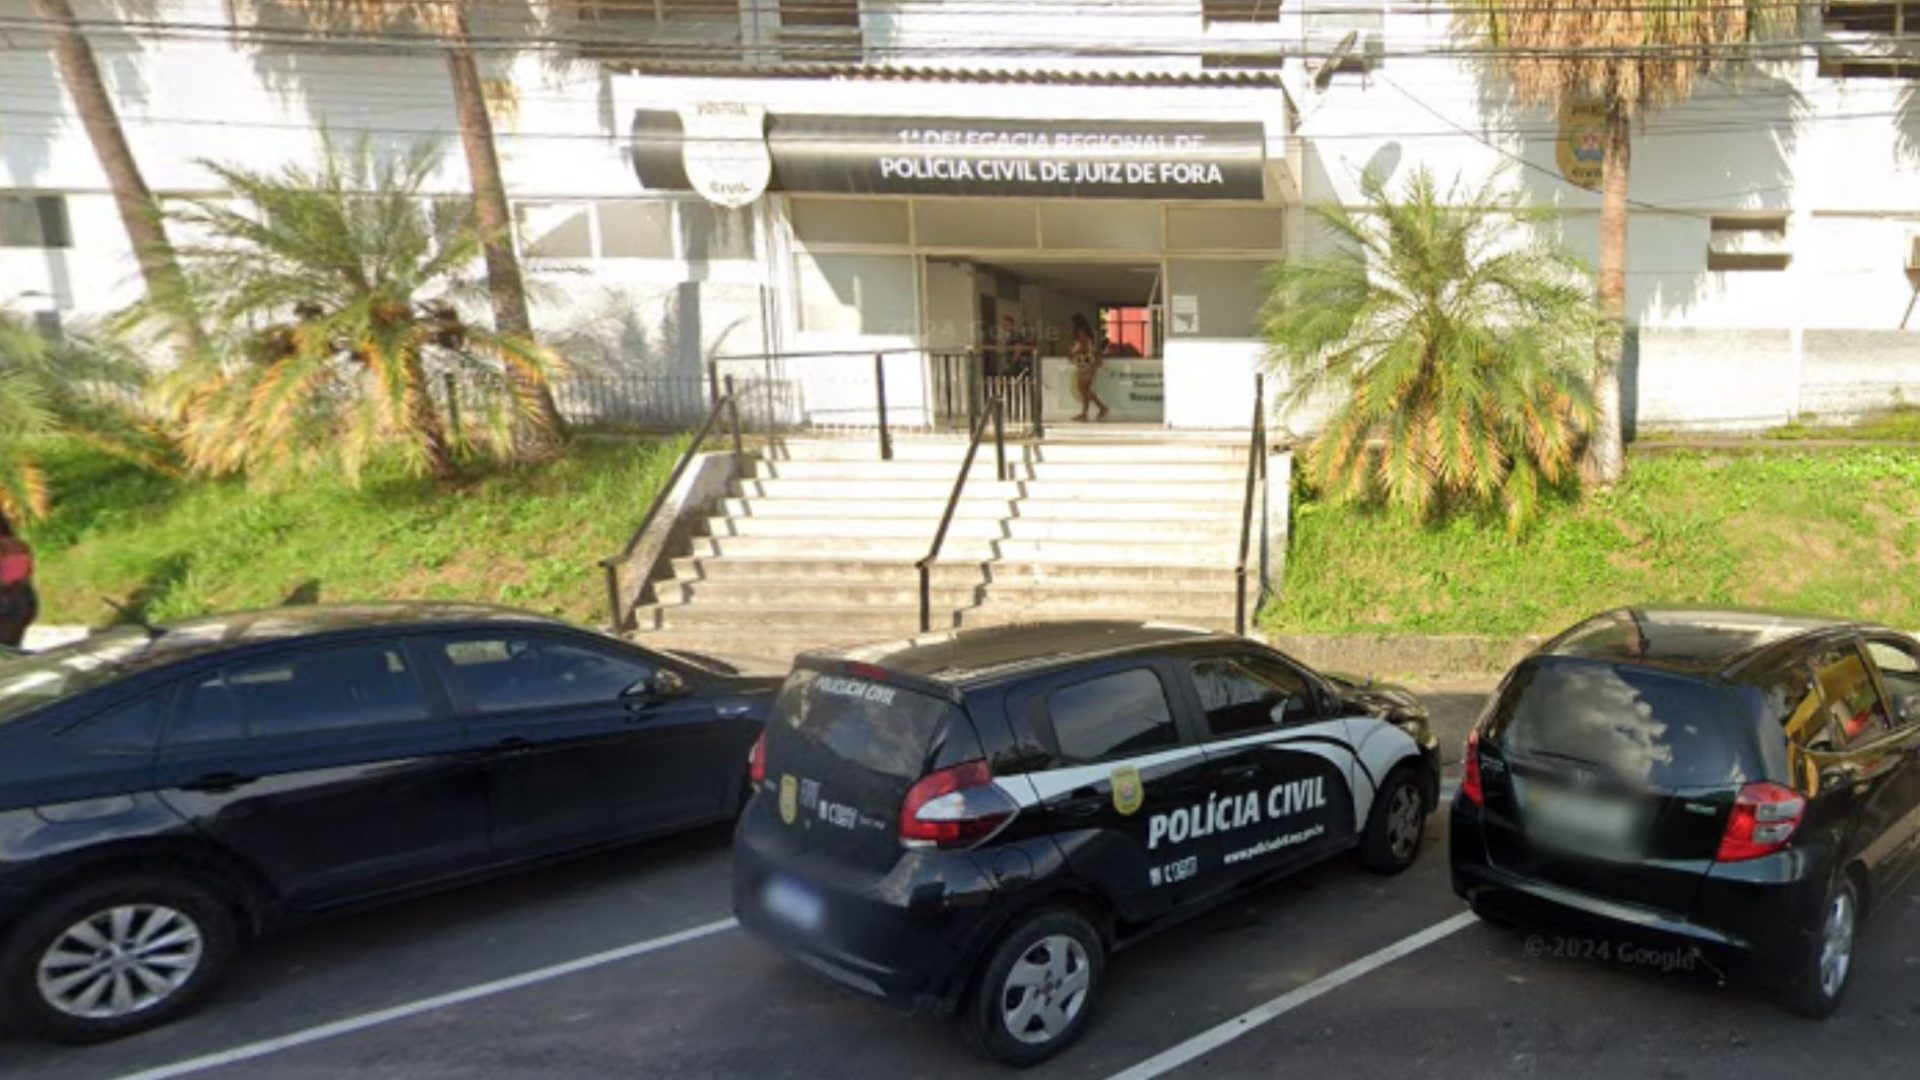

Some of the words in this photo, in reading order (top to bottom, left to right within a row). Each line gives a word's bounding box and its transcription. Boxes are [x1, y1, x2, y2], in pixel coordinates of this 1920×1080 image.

[923, 129, 1049, 153] DELEGACIA
[1055, 133, 1170, 155] REGIONAL
[1174, 135, 1205, 156] DE
[880, 154, 974, 180] POLÍCIA
[976, 159, 1038, 182] CIVIL
[1039, 161, 1071, 183] DE
[1074, 162, 1123, 184] JUIZ
[1125, 162, 1157, 184] DE
[1159, 163, 1224, 184] FORA
[1148, 791, 1261, 849] POLÍCIA
[1267, 776, 1327, 818] CIVIL
